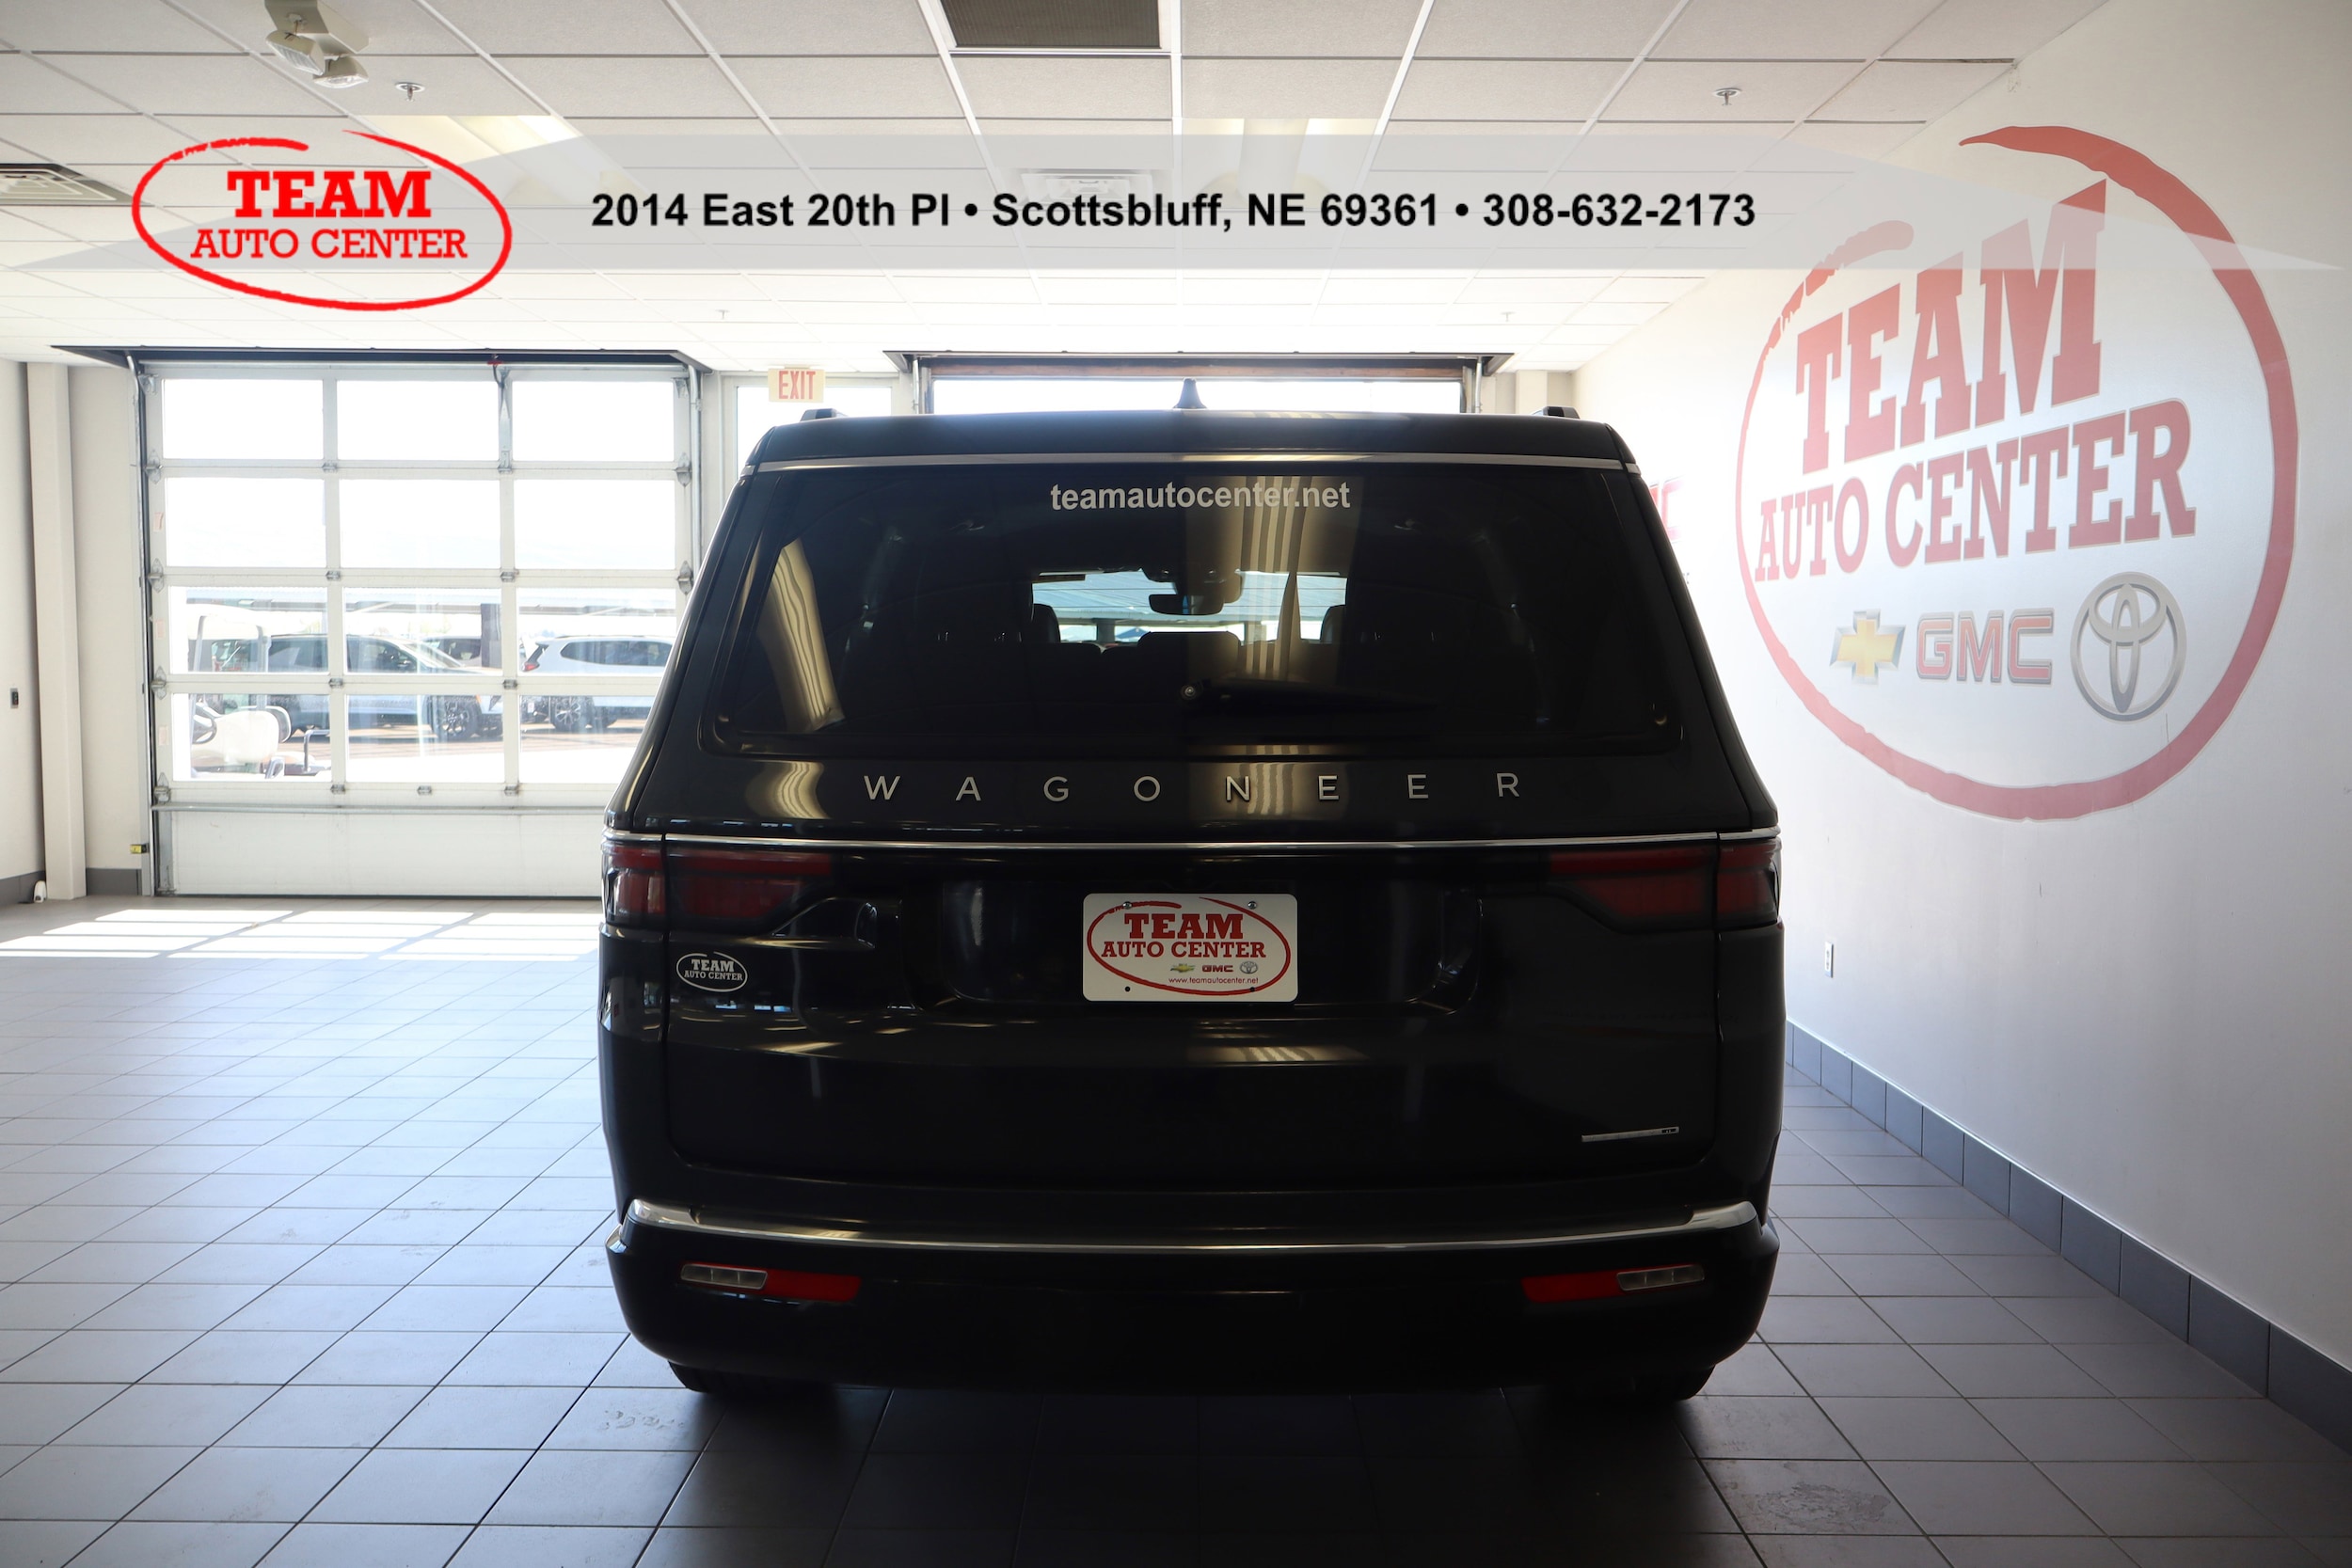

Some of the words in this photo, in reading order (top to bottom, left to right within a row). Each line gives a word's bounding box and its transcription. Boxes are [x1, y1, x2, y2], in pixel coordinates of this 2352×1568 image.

[1796, 178, 2106, 475] TEAM
[778, 370, 816, 400] EXIT
[1051, 481, 1352, 511] teamautocenter.net
[1755, 477, 1869, 583] AUTO
[1885, 398, 2197, 568] CENTER
[1915, 609, 2055, 685] GMC
[864, 772, 1520, 802] WAGONEER
[1124, 913, 1244, 939] TEAM
[1101, 941, 1165, 958] AUTO
[1170, 941, 1266, 958] CENTER
[684, 970, 706, 978] AUTO
[691, 959, 734, 972] TEAM
[1168, 976, 1259, 985] www.teamautocenter.net
